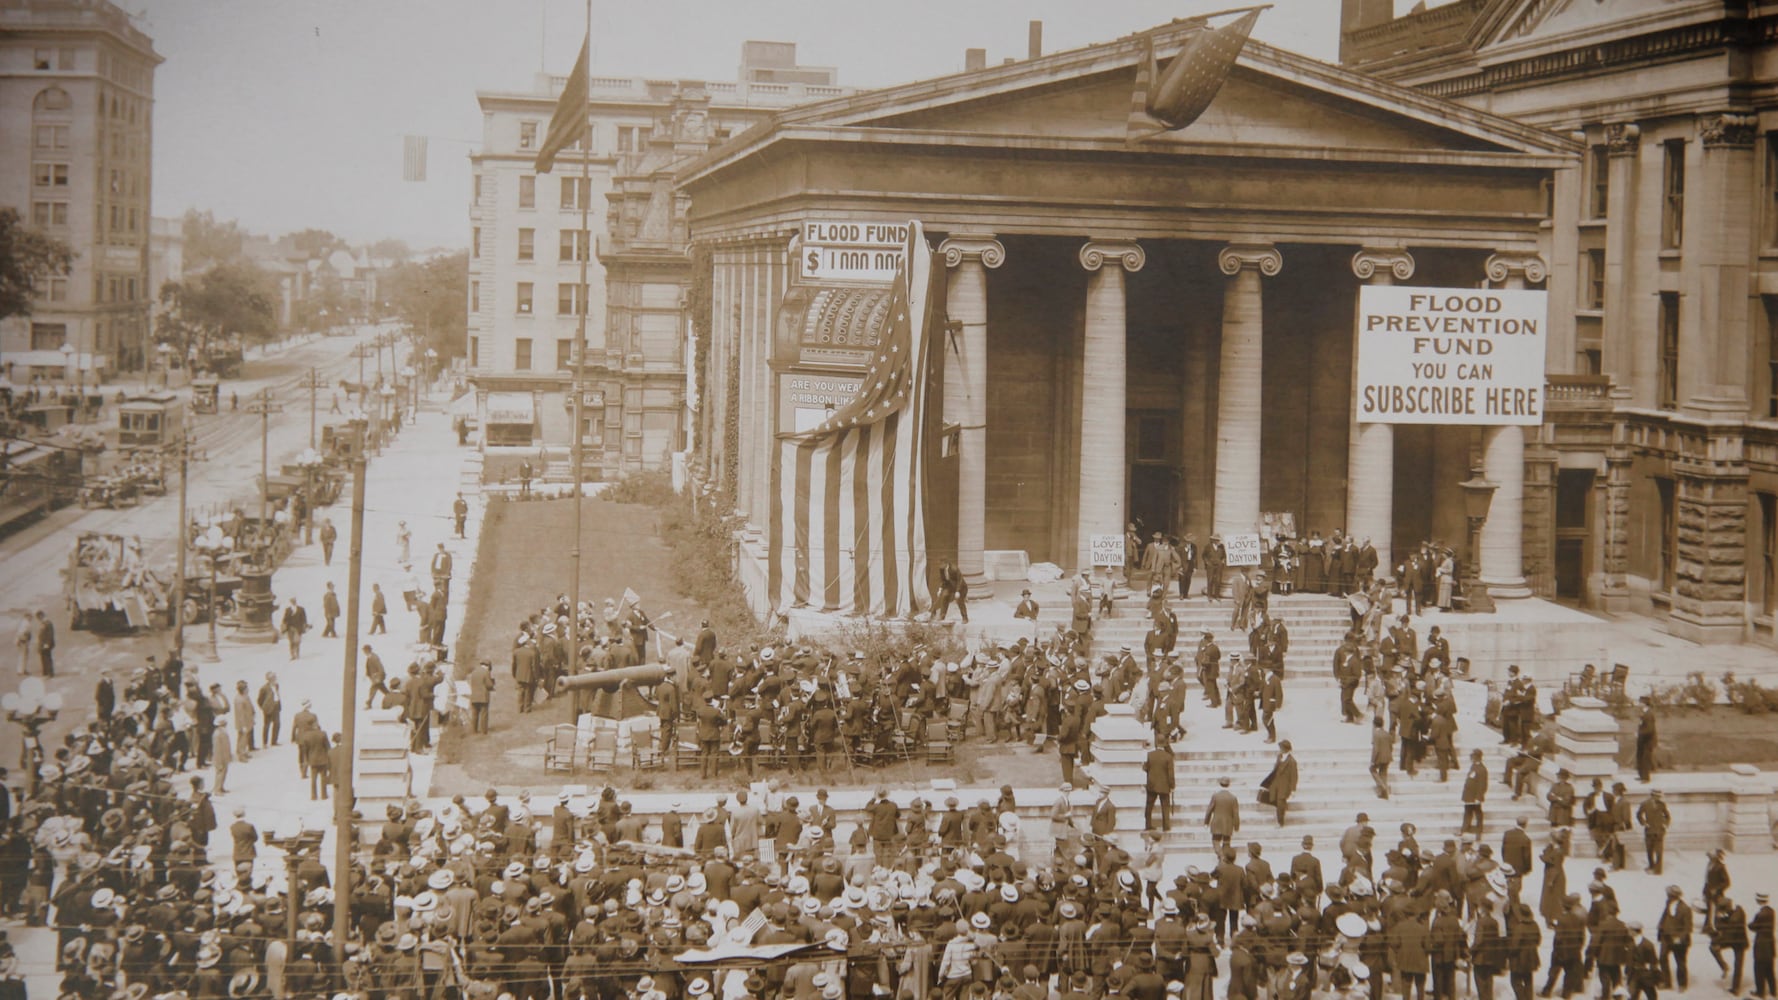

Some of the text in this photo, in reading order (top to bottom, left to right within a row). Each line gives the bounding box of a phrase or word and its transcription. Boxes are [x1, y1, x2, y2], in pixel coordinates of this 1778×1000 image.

[807, 224, 908, 243] FLOOD FUND
[807, 250, 819, 276] $
[1410, 294, 1502, 313] FLOOD
[1367, 315, 1537, 335] PREVENTION
[1413, 337, 1493, 356] FUND
[1412, 362, 1493, 380] YOU CAN
[791, 380, 810, 390] ARE
[814, 381, 834, 391] YOU
[791, 393, 798, 402] A
[800, 394, 832, 404] RIBBON
[1363, 385, 1538, 416] SUBSCRIBE HERE
[1093, 540, 1122, 549] LOVE
[1227, 540, 1257, 549] LOVE
[1093, 551, 1122, 563] DAYTON
[1229, 552, 1258, 563] DAYTON
